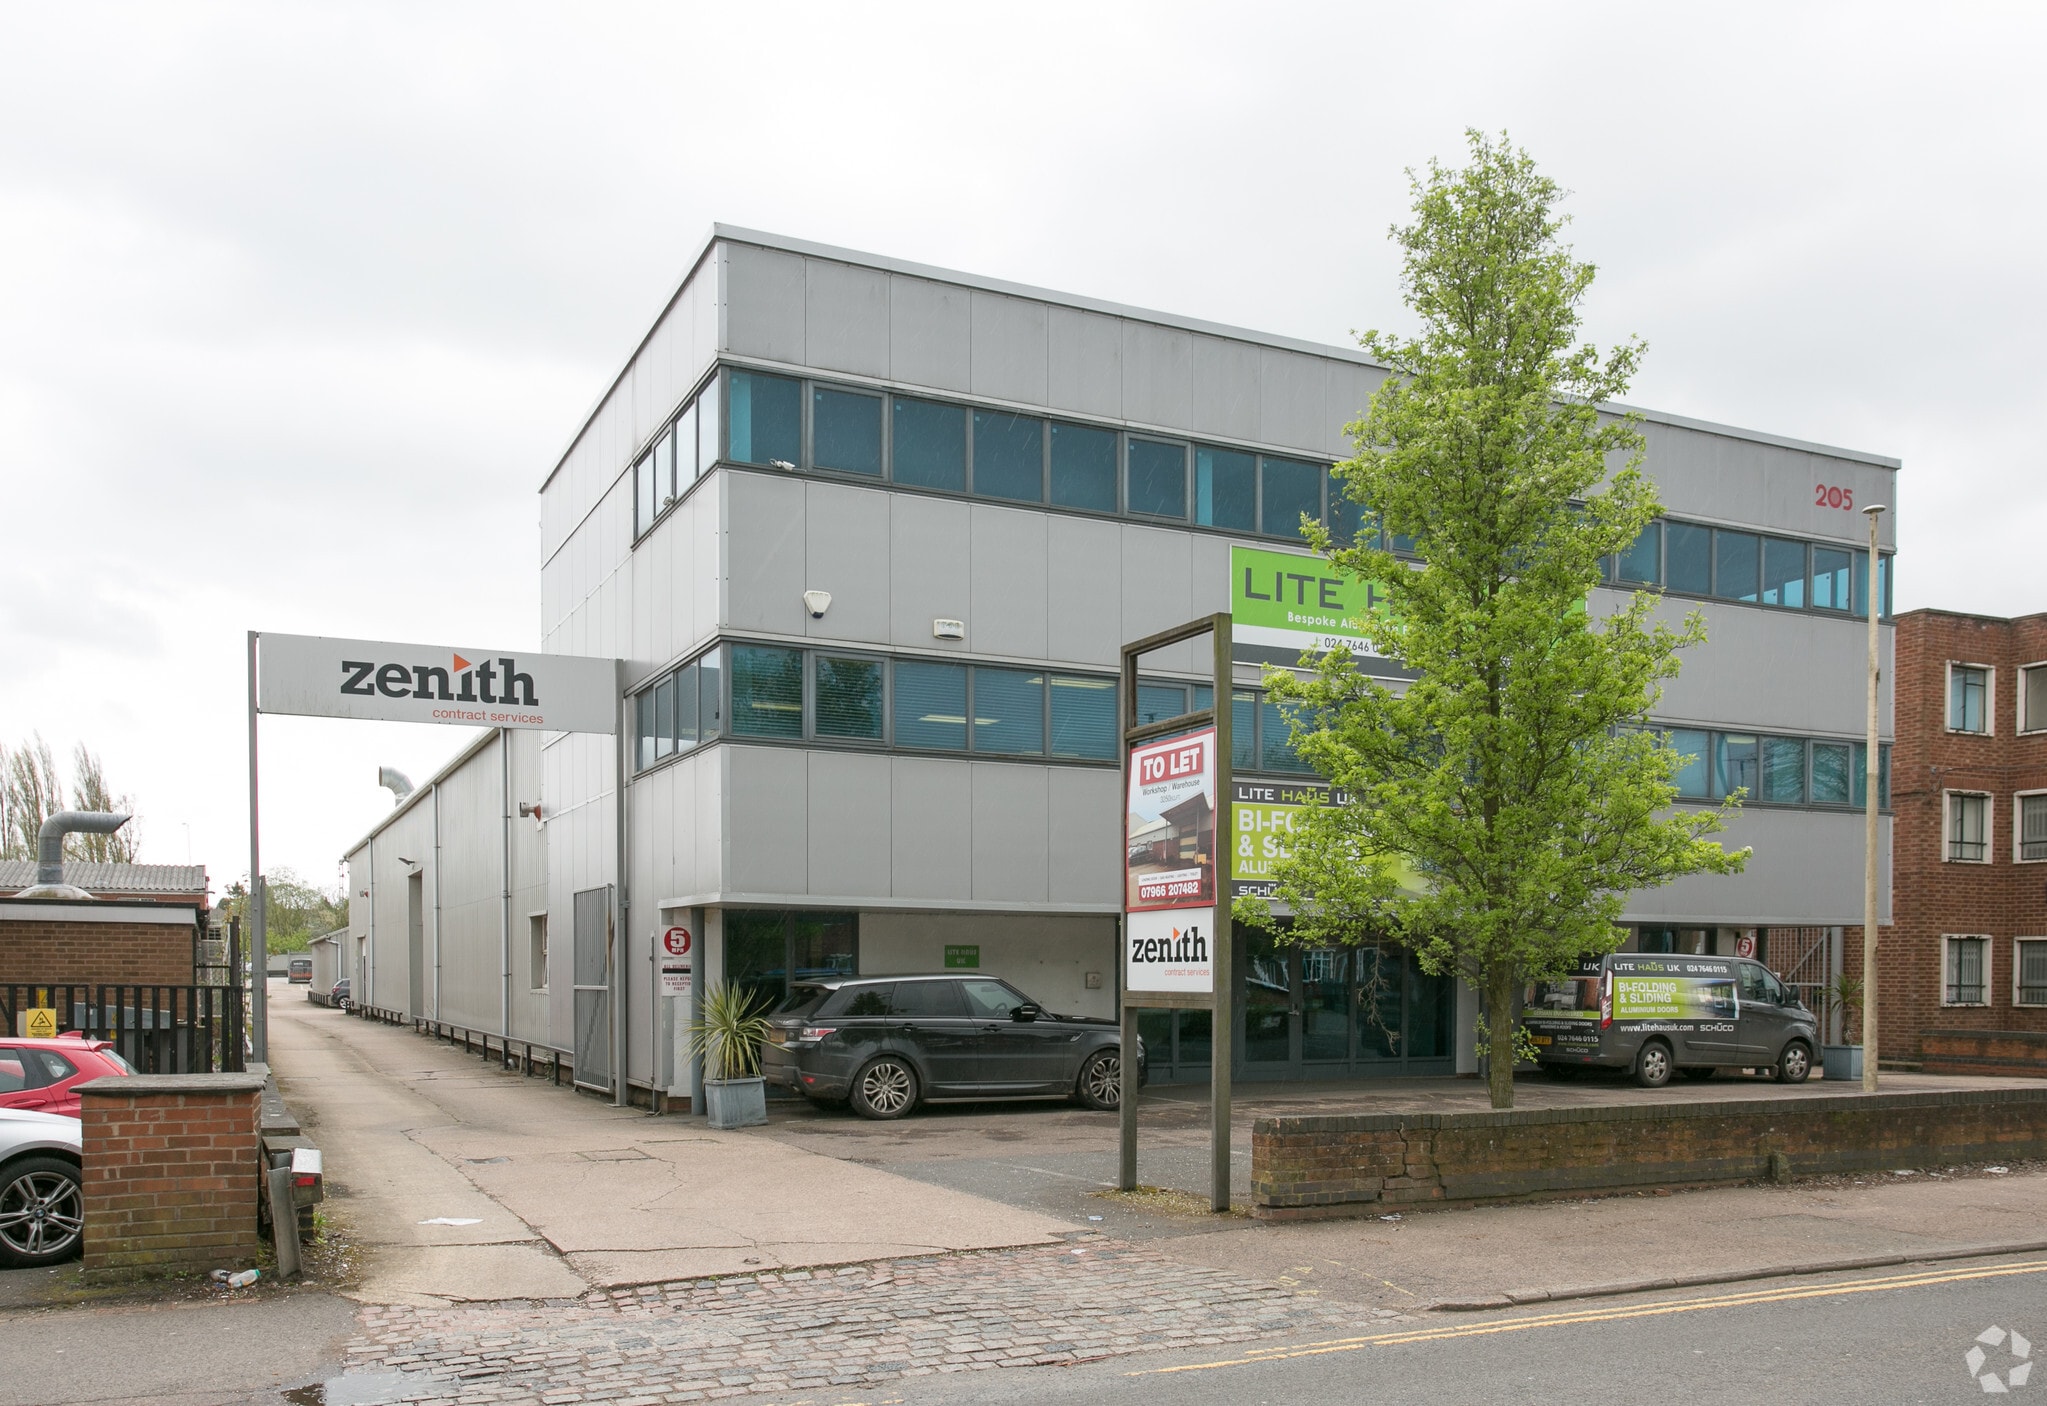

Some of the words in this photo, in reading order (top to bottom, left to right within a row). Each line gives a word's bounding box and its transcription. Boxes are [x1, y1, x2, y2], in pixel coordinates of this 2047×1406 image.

[1815, 483, 1853, 511] 205
[1245, 567, 1344, 610] LITE
[1287, 611, 1336, 627] Bespoke
[1346, 640, 1369, 652] 7646
[340, 653, 539, 706] zenith
[432, 709, 487, 722] contract
[490, 711, 544, 724] services
[1143, 756, 1166, 780] TO
[1170, 747, 1200, 775] LET
[1142, 785, 1168, 796] Workshop
[1172, 779, 1201, 791] Warehouse
[1238, 787, 1275, 801] LITE
[1238, 834, 1255, 858] &
[1141, 885, 1167, 899] 07966
[1168, 881, 1199, 896] 207482
[670, 930, 685, 948] 5
[1131, 926, 1208, 963] zenith
[1741, 939, 1750, 952] 5
[1187, 968, 1210, 976] services
[1583, 962, 1600, 971] UK
[1614, 963, 1635, 971] LITE
[1667, 964, 1680, 972] UK
[1687, 965, 1700, 973] 024
[1618, 982, 1677, 993] BI-FOLDING
[1619, 993, 1627, 1004] &
[1630, 993, 1672, 1004] SLIDING
[1620, 1006, 1656, 1014] ALUMINIUM
[1620, 1022, 1694, 1032] www.litehausuk.com
